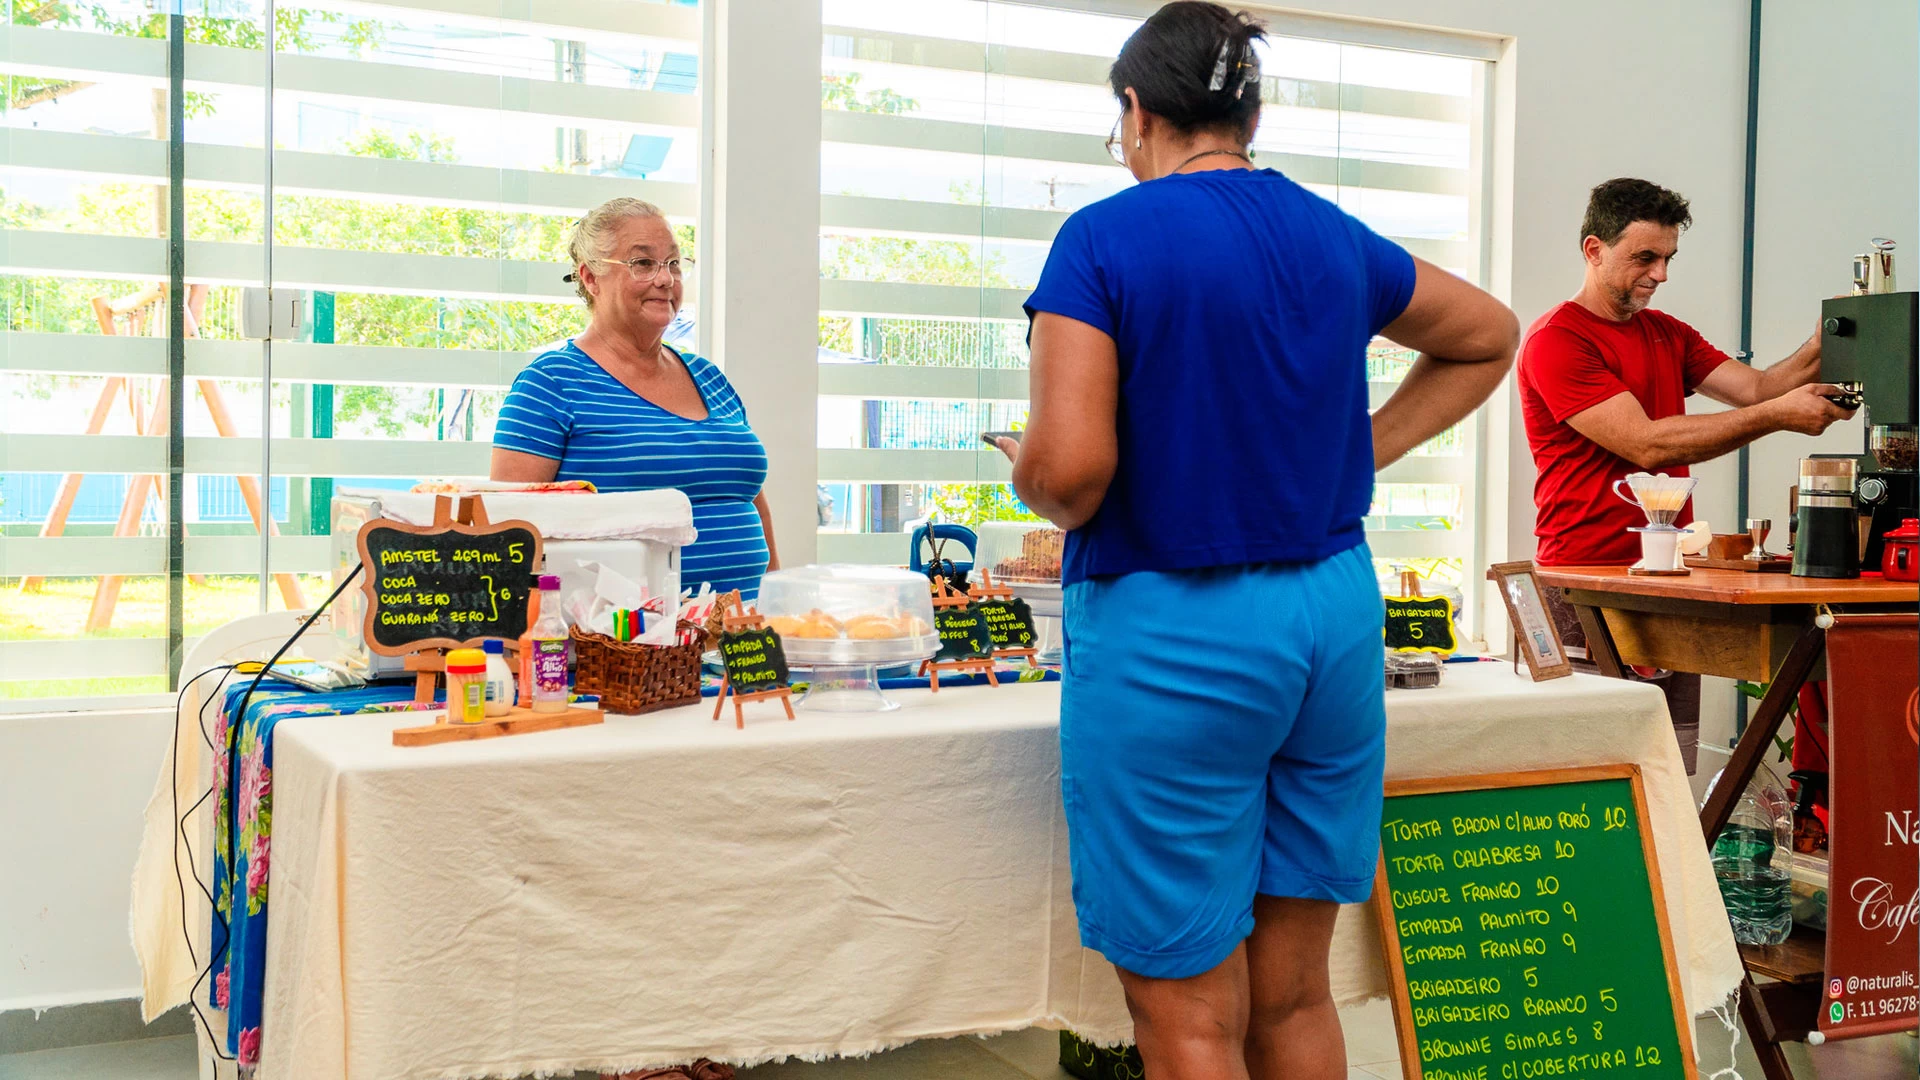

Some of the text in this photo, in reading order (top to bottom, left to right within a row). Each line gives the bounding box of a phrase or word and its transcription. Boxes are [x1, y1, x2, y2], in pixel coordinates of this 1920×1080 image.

[380, 549, 441, 566] AMSTEL
[508, 542, 524, 564] 5
[382, 575, 417, 589] COCA
[380, 592, 412, 605] COCA
[415, 592, 451, 606] ZERO
[500, 587, 512, 601] 6
[381, 608, 485, 626] GUARANÁ ZERO
[979, 606, 1007, 616] TORTA
[1387, 608, 1446, 618] BRIGADEIRO
[1019, 631, 1031, 644] 10
[1409, 621, 1424, 640] 5
[724, 635, 776, 655] EMPADA 9
[969, 638, 981, 653] 8
[736, 652, 767, 668] FRANGO
[741, 669, 777, 684] PALMITO
[1384, 819, 1442, 842] TORTA
[1451, 815, 1501, 837] BACON
[1557, 803, 1591, 830] PORÓ
[1603, 806, 1627, 832] 10
[1391, 839, 1576, 874] TORTA CALABRESA 10
[1393, 875, 1560, 910] CUSCUZ FRANGO 10
[1399, 901, 1578, 938] EMPADA PALMITO 9
[1404, 932, 1577, 965] EMPADA FRANGO 9
[1411, 966, 1539, 1000] BRIGADEIRO 5
[1847, 970, 1919, 995] @naturalis_
[1415, 987, 1617, 1028] BRIGADEIRO BRANCO 5
[1847, 1002, 1857, 1019] F.
[1860, 1000, 1876, 1017] 11
[1420, 1020, 1605, 1063] BROWNIE SIMPLES 8
[1424, 1065, 1488, 1080] BROWNIE
[1635, 1045, 1662, 1068] 12
